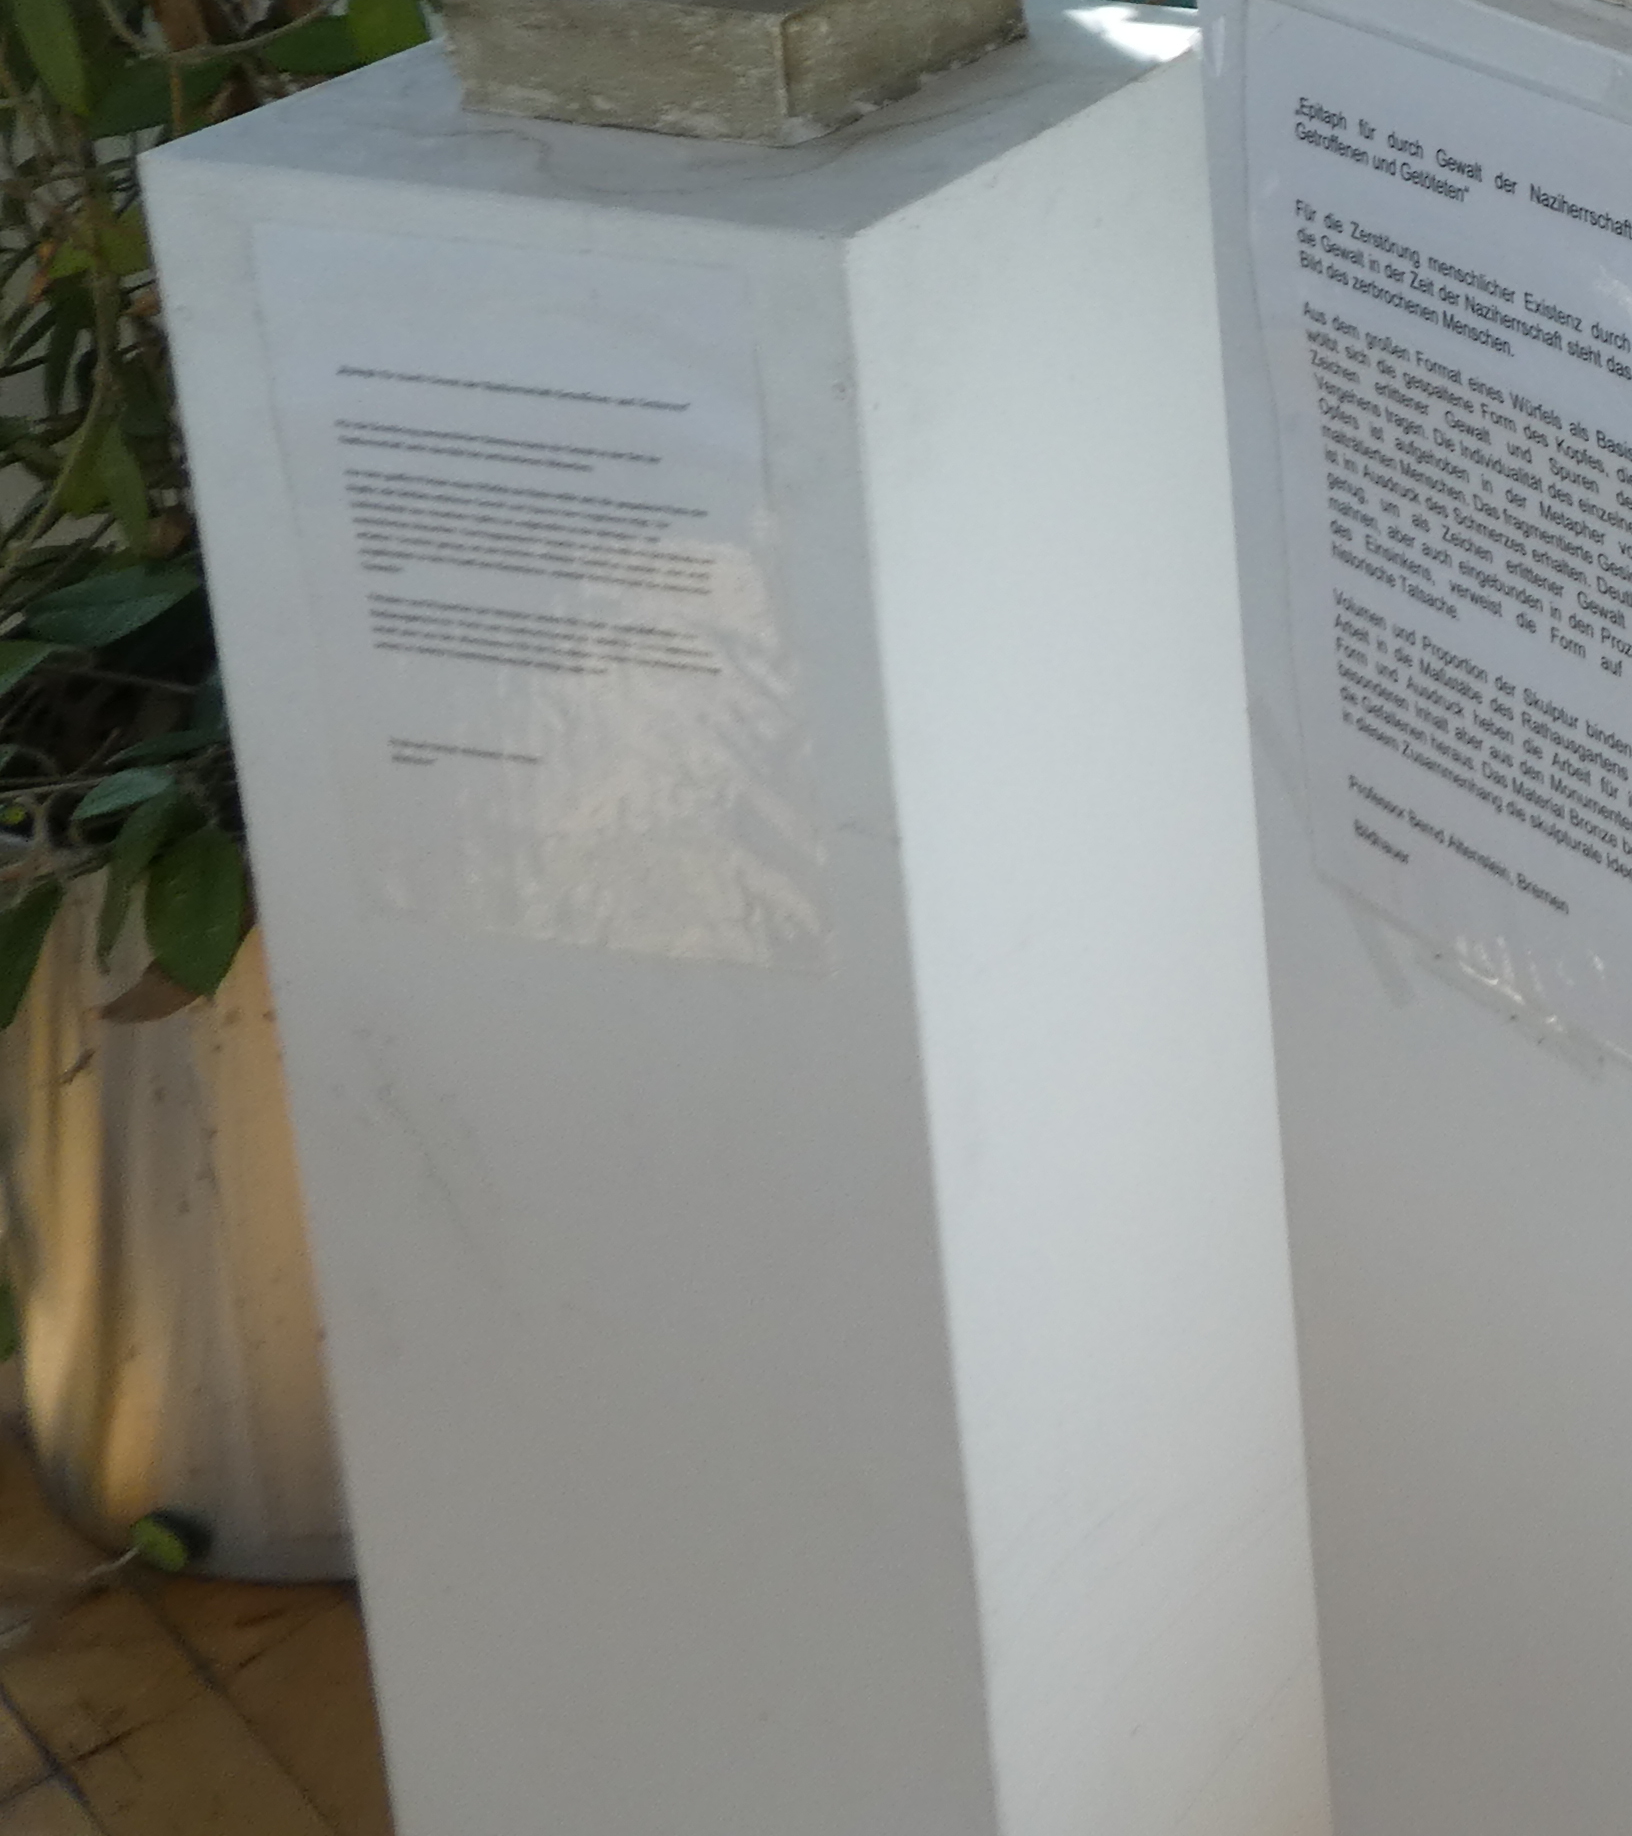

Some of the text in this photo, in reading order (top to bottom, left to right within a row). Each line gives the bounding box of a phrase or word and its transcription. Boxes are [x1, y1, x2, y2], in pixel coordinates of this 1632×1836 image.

[1294, 122, 1370, 165] Getroffenen
[1371, 154, 1397, 177] und
[1357, 117, 1377, 141] für
[1386, 130, 1424, 159] durch
[1434, 147, 1483, 182] Gewalt
[1493, 171, 1519, 195] der
[1529, 183, 1632, 238] Naziherrschaft
[1294, 198, 1632, 352] Für die Zerstörung menschlicher Existenz durch
[1295, 226, 1632, 381] die Gewalt in der Zeit der Naziherrschaft steht das
[1298, 249, 1514, 357] Bild des zerbrochenen Menschen.
